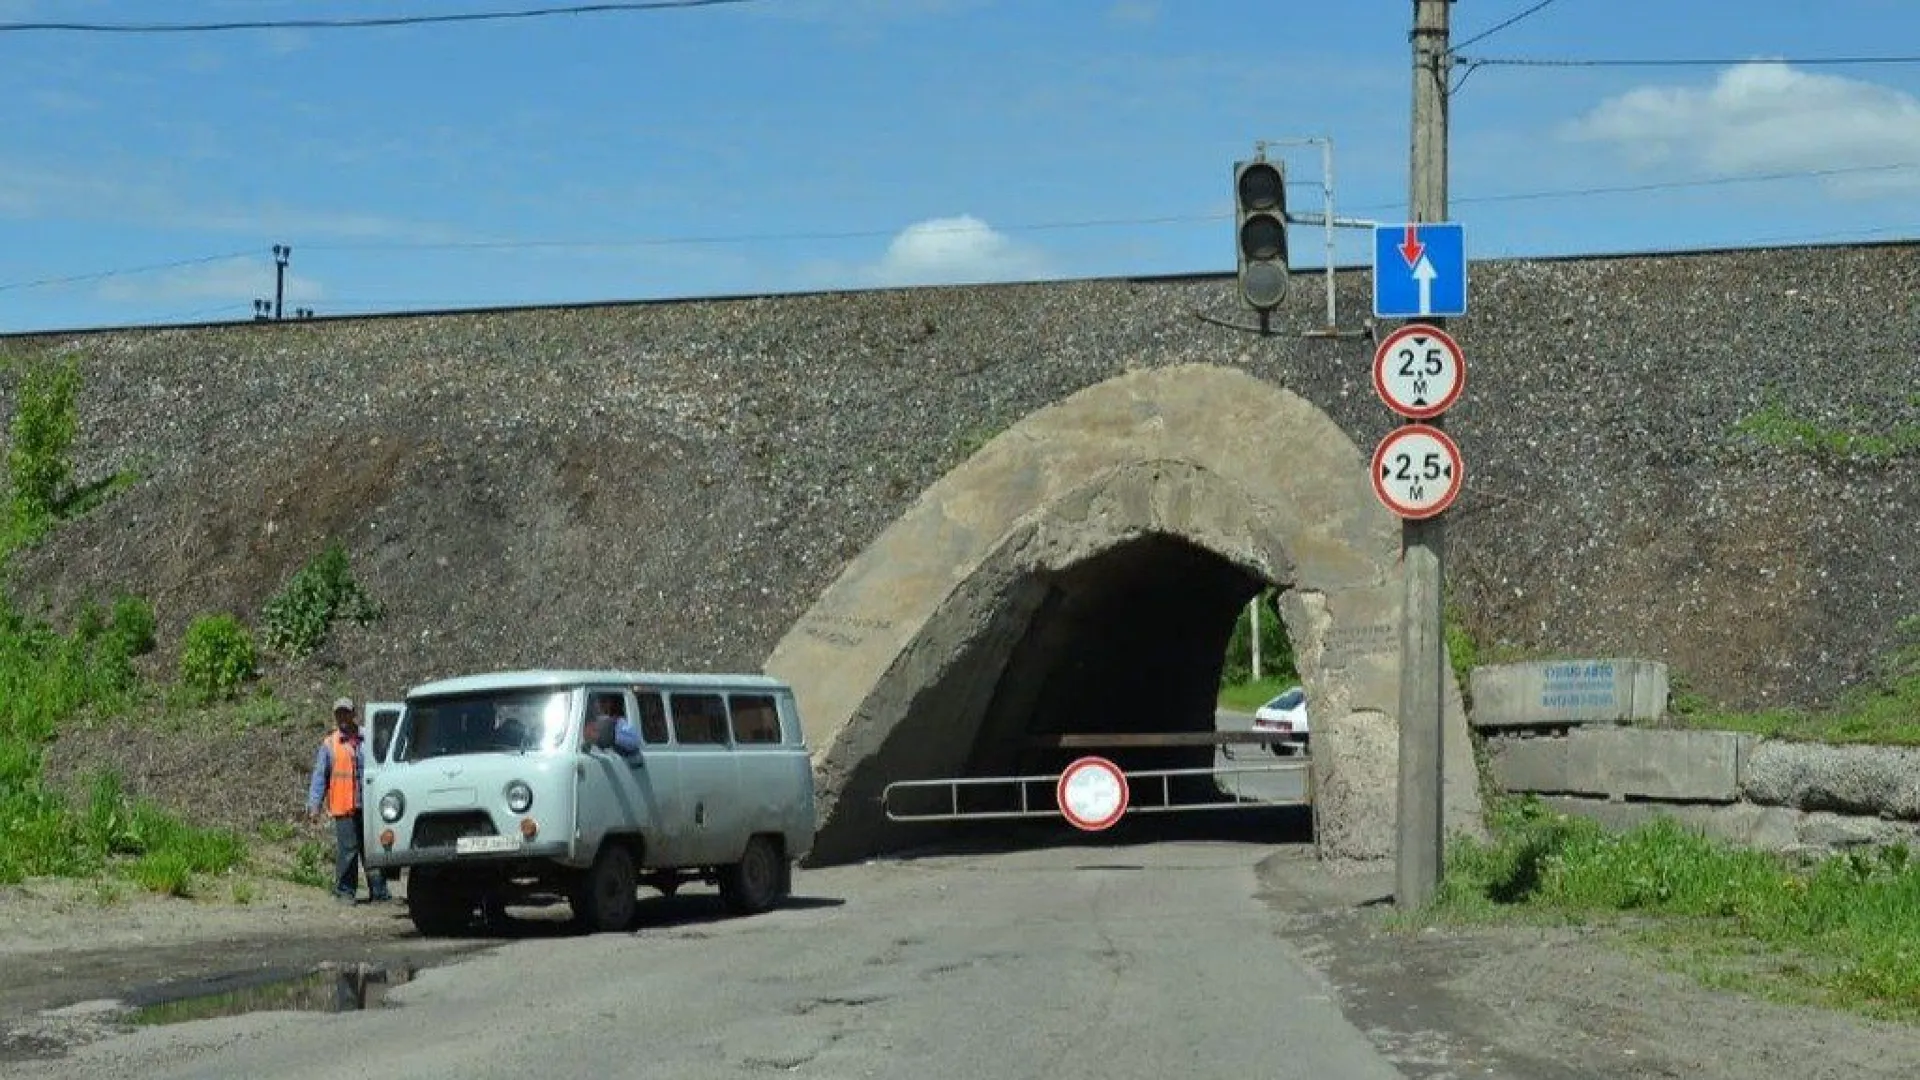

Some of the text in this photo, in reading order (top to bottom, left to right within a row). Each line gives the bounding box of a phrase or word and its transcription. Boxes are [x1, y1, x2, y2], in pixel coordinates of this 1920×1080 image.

[1398, 349, 1443, 380] 2,5
[1413, 380, 1427, 394] М
[1395, 453, 1440, 484] 2,5
[1409, 486, 1423, 500] М
